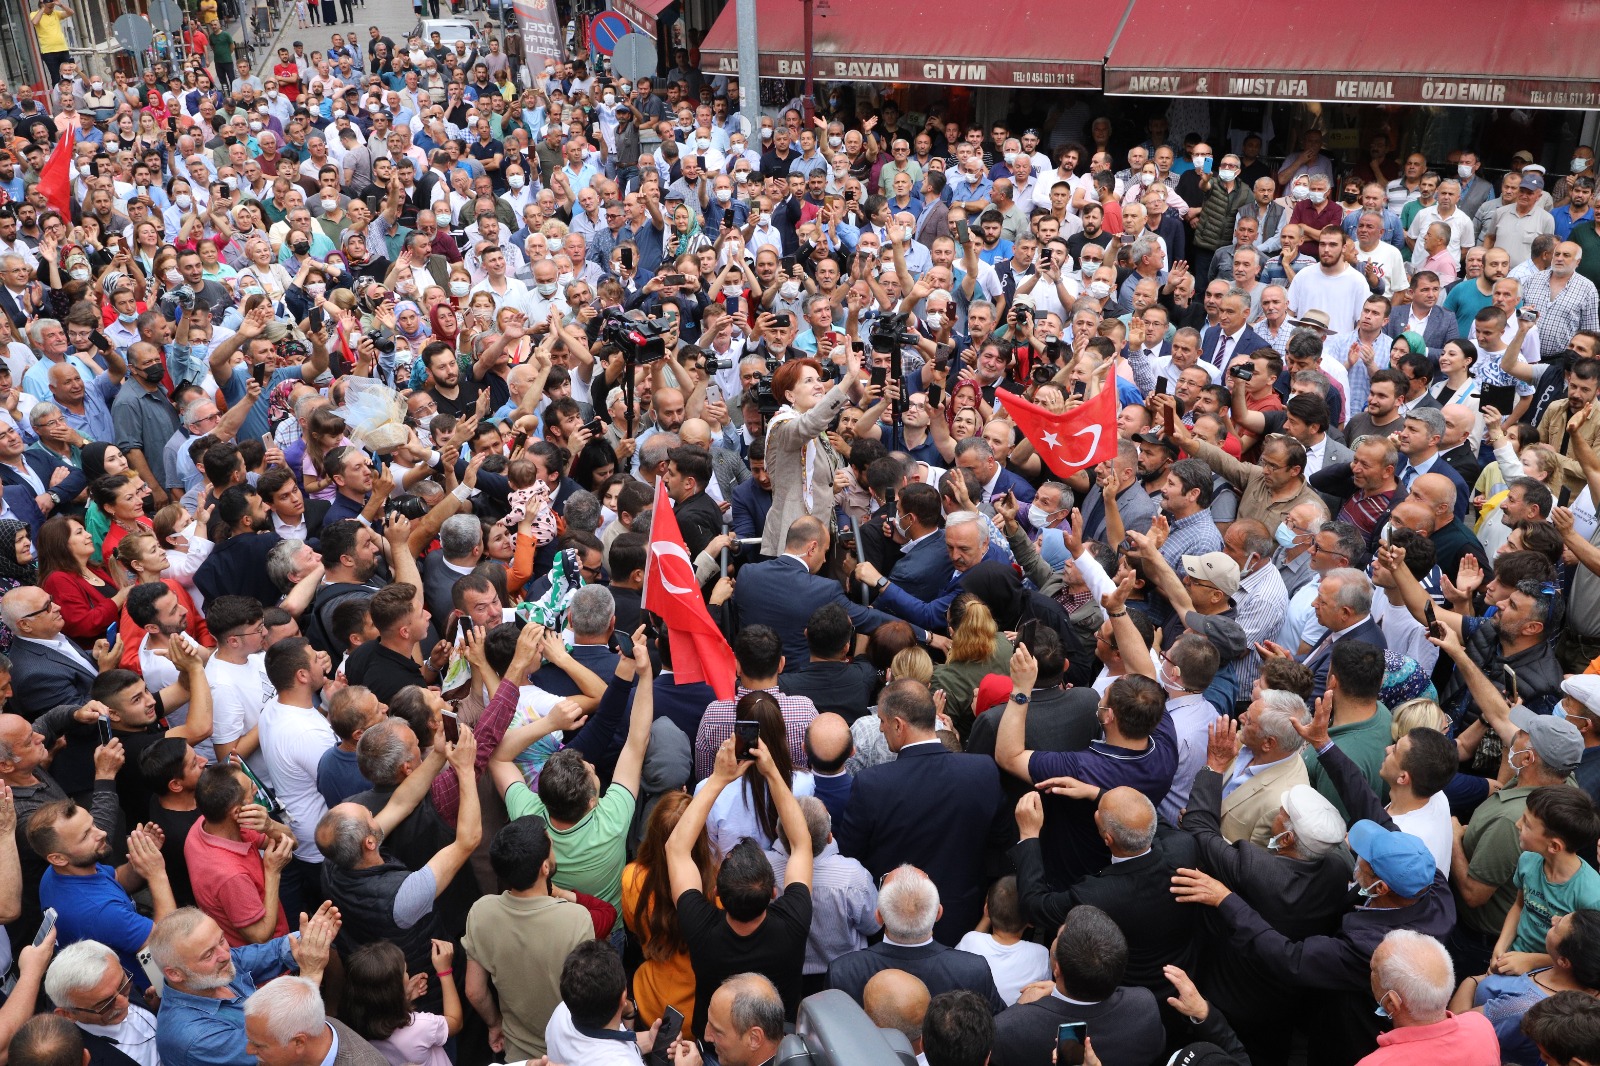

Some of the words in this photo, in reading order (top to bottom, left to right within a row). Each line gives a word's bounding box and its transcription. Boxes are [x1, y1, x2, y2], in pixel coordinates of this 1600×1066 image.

[718, 57, 738, 72] AD
[778, 60, 805, 74] BA
[834, 61, 899, 78] BAYAN
[923, 60, 986, 80] GİYİM
[1012, 72, 1025, 82] TEL:
[1026, 72, 1030, 82] 0
[1032, 72, 1043, 83] 454
[1057, 74, 1064, 84] 21
[1067, 74, 1074, 84] 15
[1128, 76, 1180, 92] AKBAY
[1196, 78, 1208, 92] &
[1228, 78, 1308, 96] MUSTAFA
[1335, 80, 1394, 98] KEMAL
[1422, 77, 1506, 102] ÖZDEMİR
[1530, 90, 1545, 104] TEL:
[1586, 93, 1594, 104] 21
